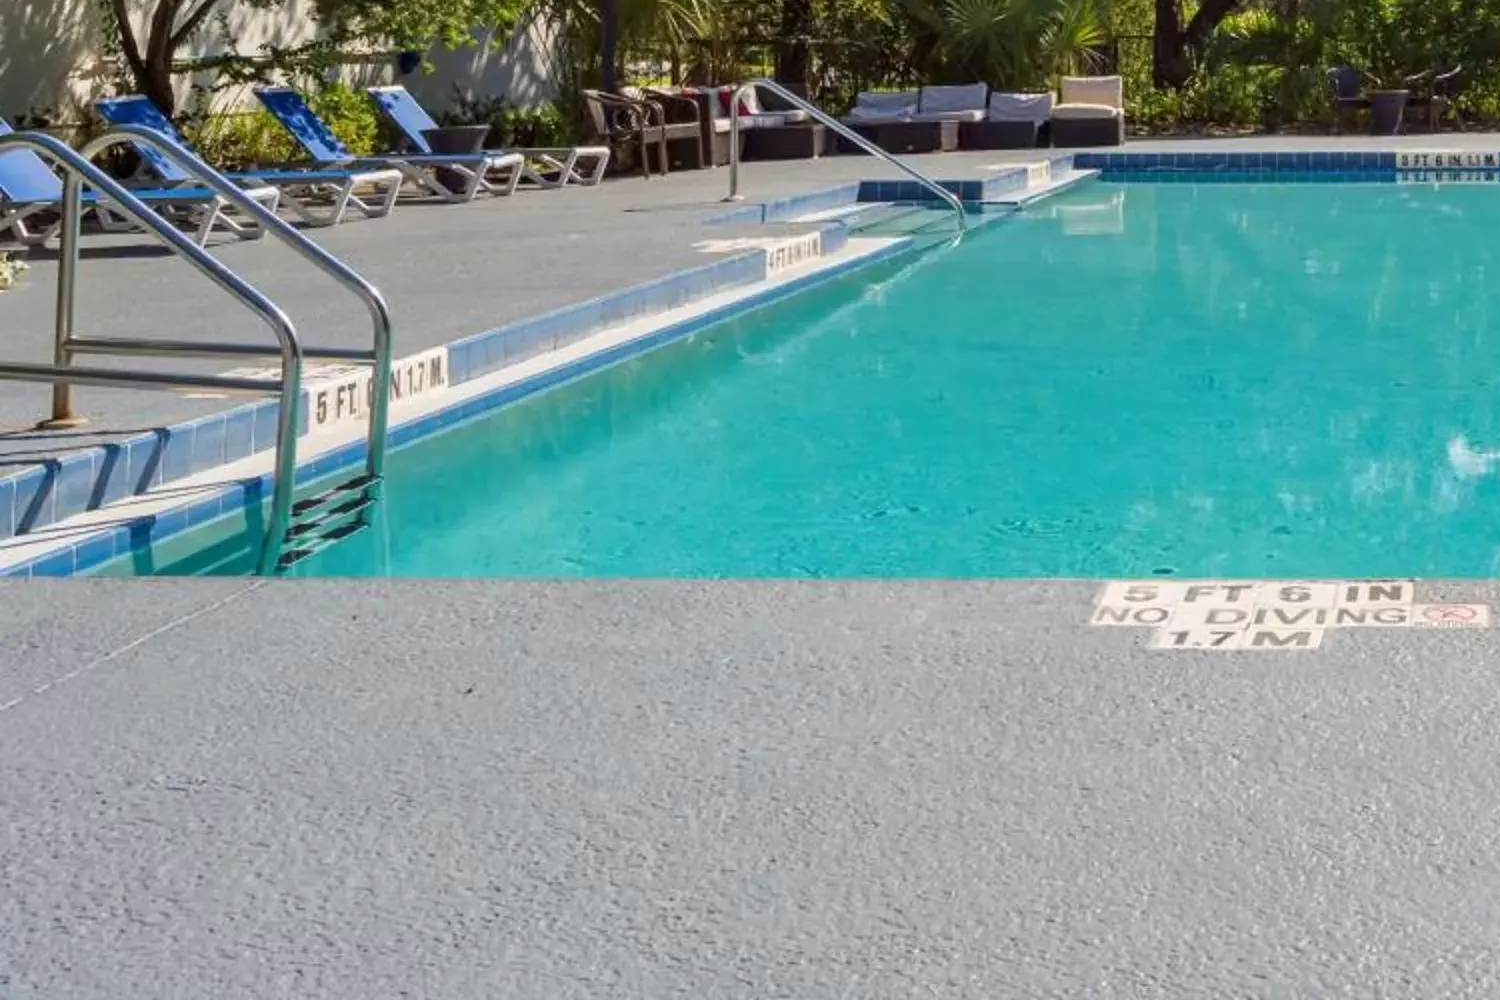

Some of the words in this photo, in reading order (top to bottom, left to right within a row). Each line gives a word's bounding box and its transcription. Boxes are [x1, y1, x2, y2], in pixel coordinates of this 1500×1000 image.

[316, 390, 328, 425] 5
[407, 361, 425, 397] 1.7
[431, 355, 445, 389] M.
[1122, 585, 1159, 602] 5
[1183, 584, 1253, 603] FT
[1279, 585, 1312, 603] 6
[1345, 584, 1403, 602] IN
[1095, 606, 1169, 624] NO
[1204, 606, 1408, 625] DIVING
[1168, 630, 1237, 647] 1.7
[1251, 631, 1312, 647] M
